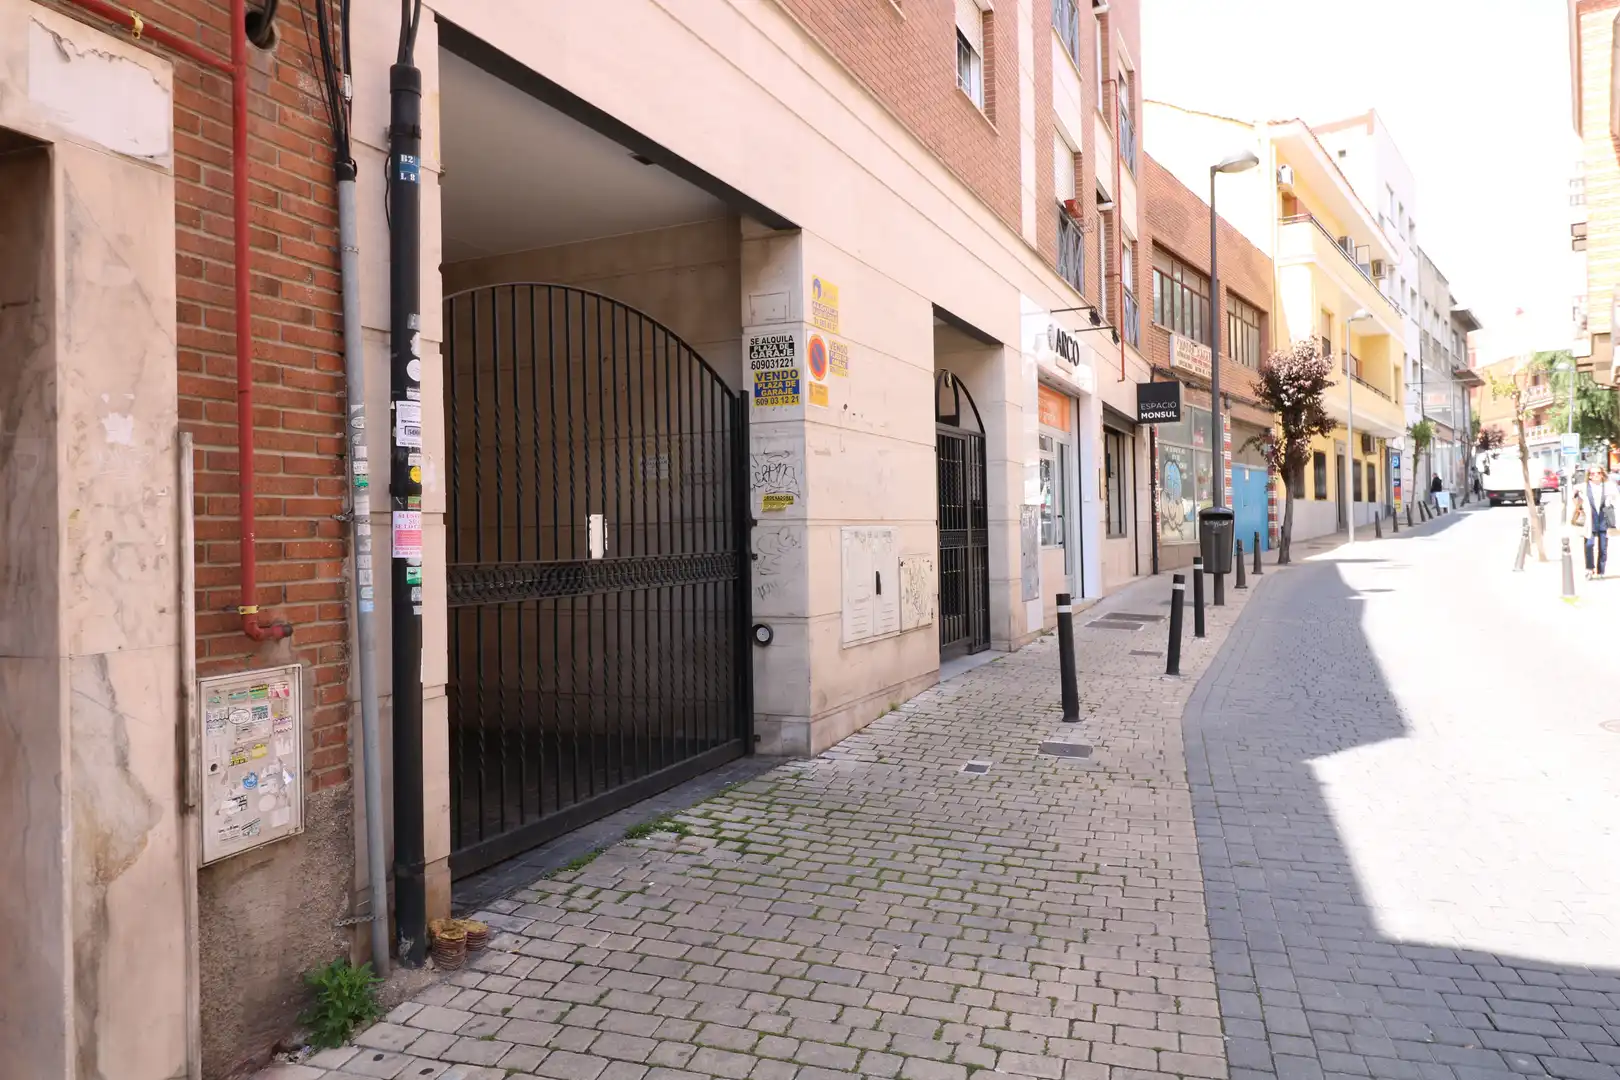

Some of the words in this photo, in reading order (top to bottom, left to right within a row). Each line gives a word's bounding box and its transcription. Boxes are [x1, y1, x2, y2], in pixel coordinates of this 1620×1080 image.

[401, 155, 413, 163] B2
[750, 337, 760, 345] SE
[761, 335, 794, 344] ALQUILA
[754, 344, 778, 352] PLAZA
[1056, 328, 1079, 366] ARCO
[751, 349, 794, 358] GARAJE
[751, 358, 794, 370] 609031221
[756, 370, 798, 381] VENDO
[761, 387, 793, 396] GARAJE
[770, 397, 779, 405] 03
[781, 396, 789, 404] 12
[791, 395, 799, 403] 21
[1140, 401, 1177, 410] ESPACIO
[1141, 410, 1177, 419] MONSUL
